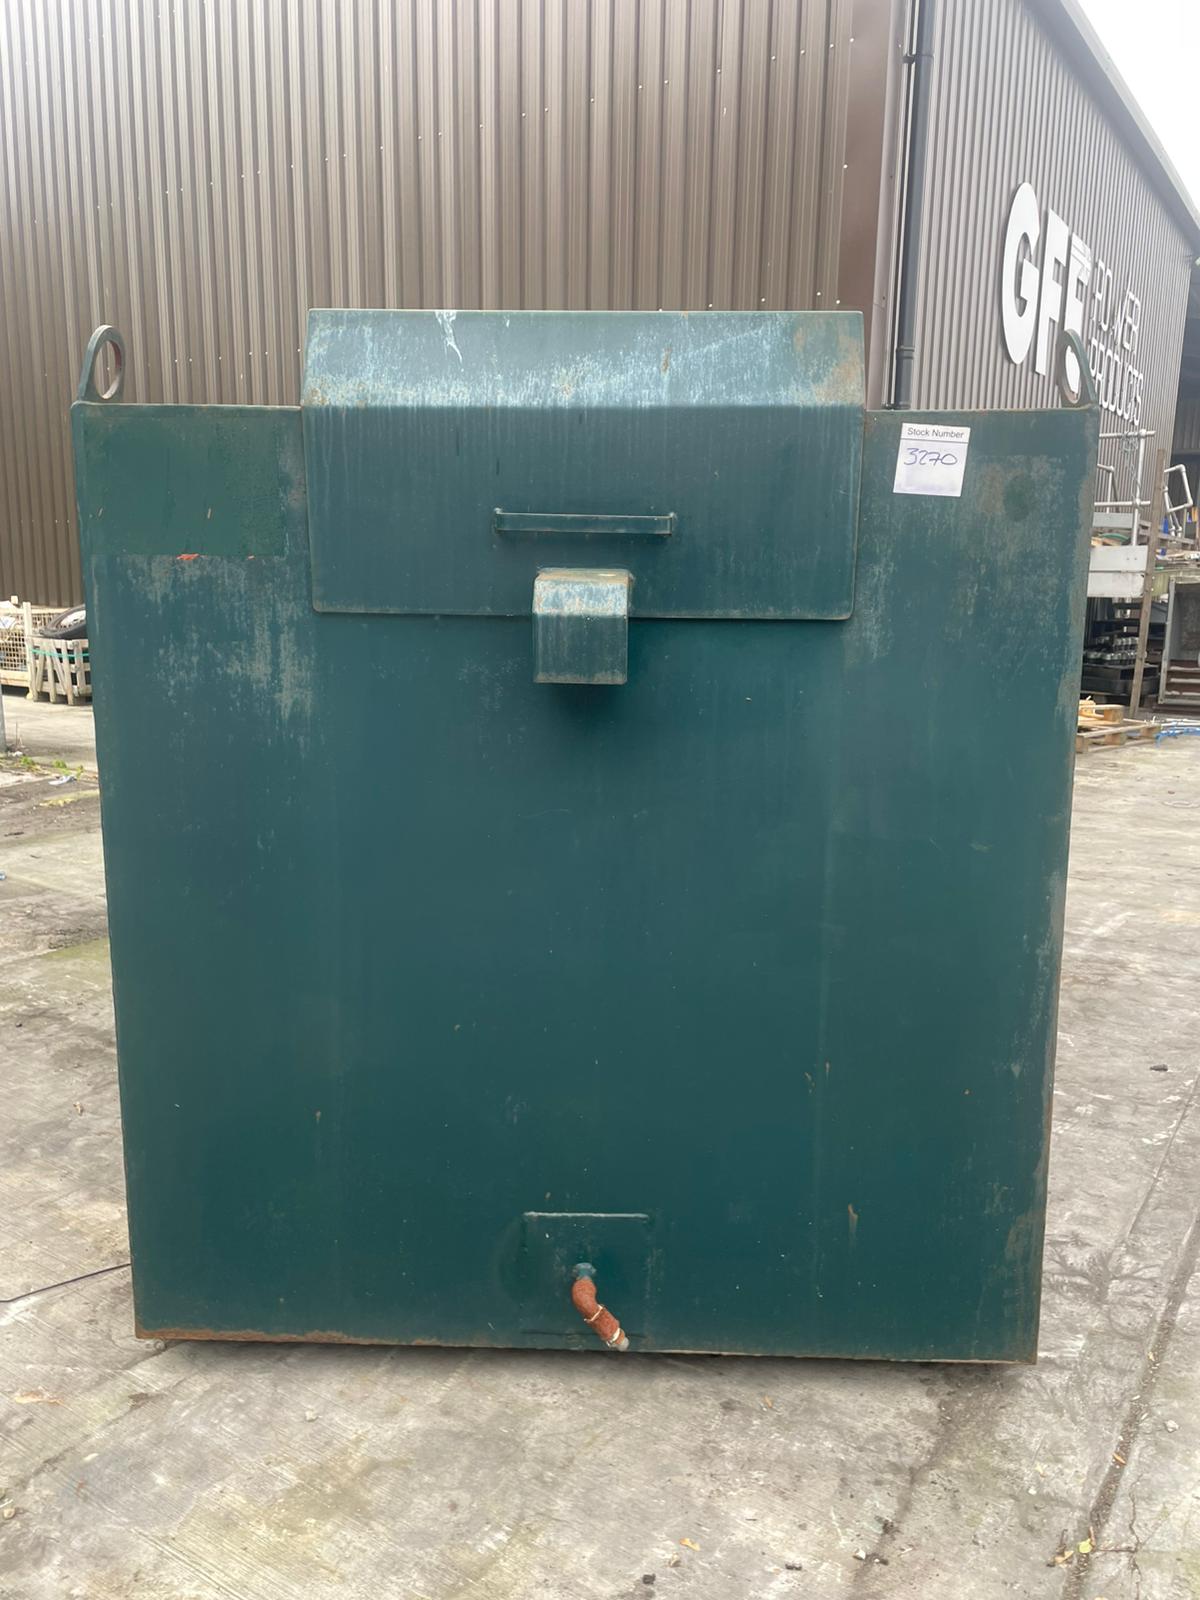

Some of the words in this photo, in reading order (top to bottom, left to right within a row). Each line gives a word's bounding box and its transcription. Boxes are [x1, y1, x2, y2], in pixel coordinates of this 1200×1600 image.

[1091, 258, 1141, 353] POWER
[1088, 337, 1143, 426] PRODUCTS
[904, 447, 958, 467] 3270
[907, 427, 930, 437] Stock
[931, 430, 964, 439] Number
